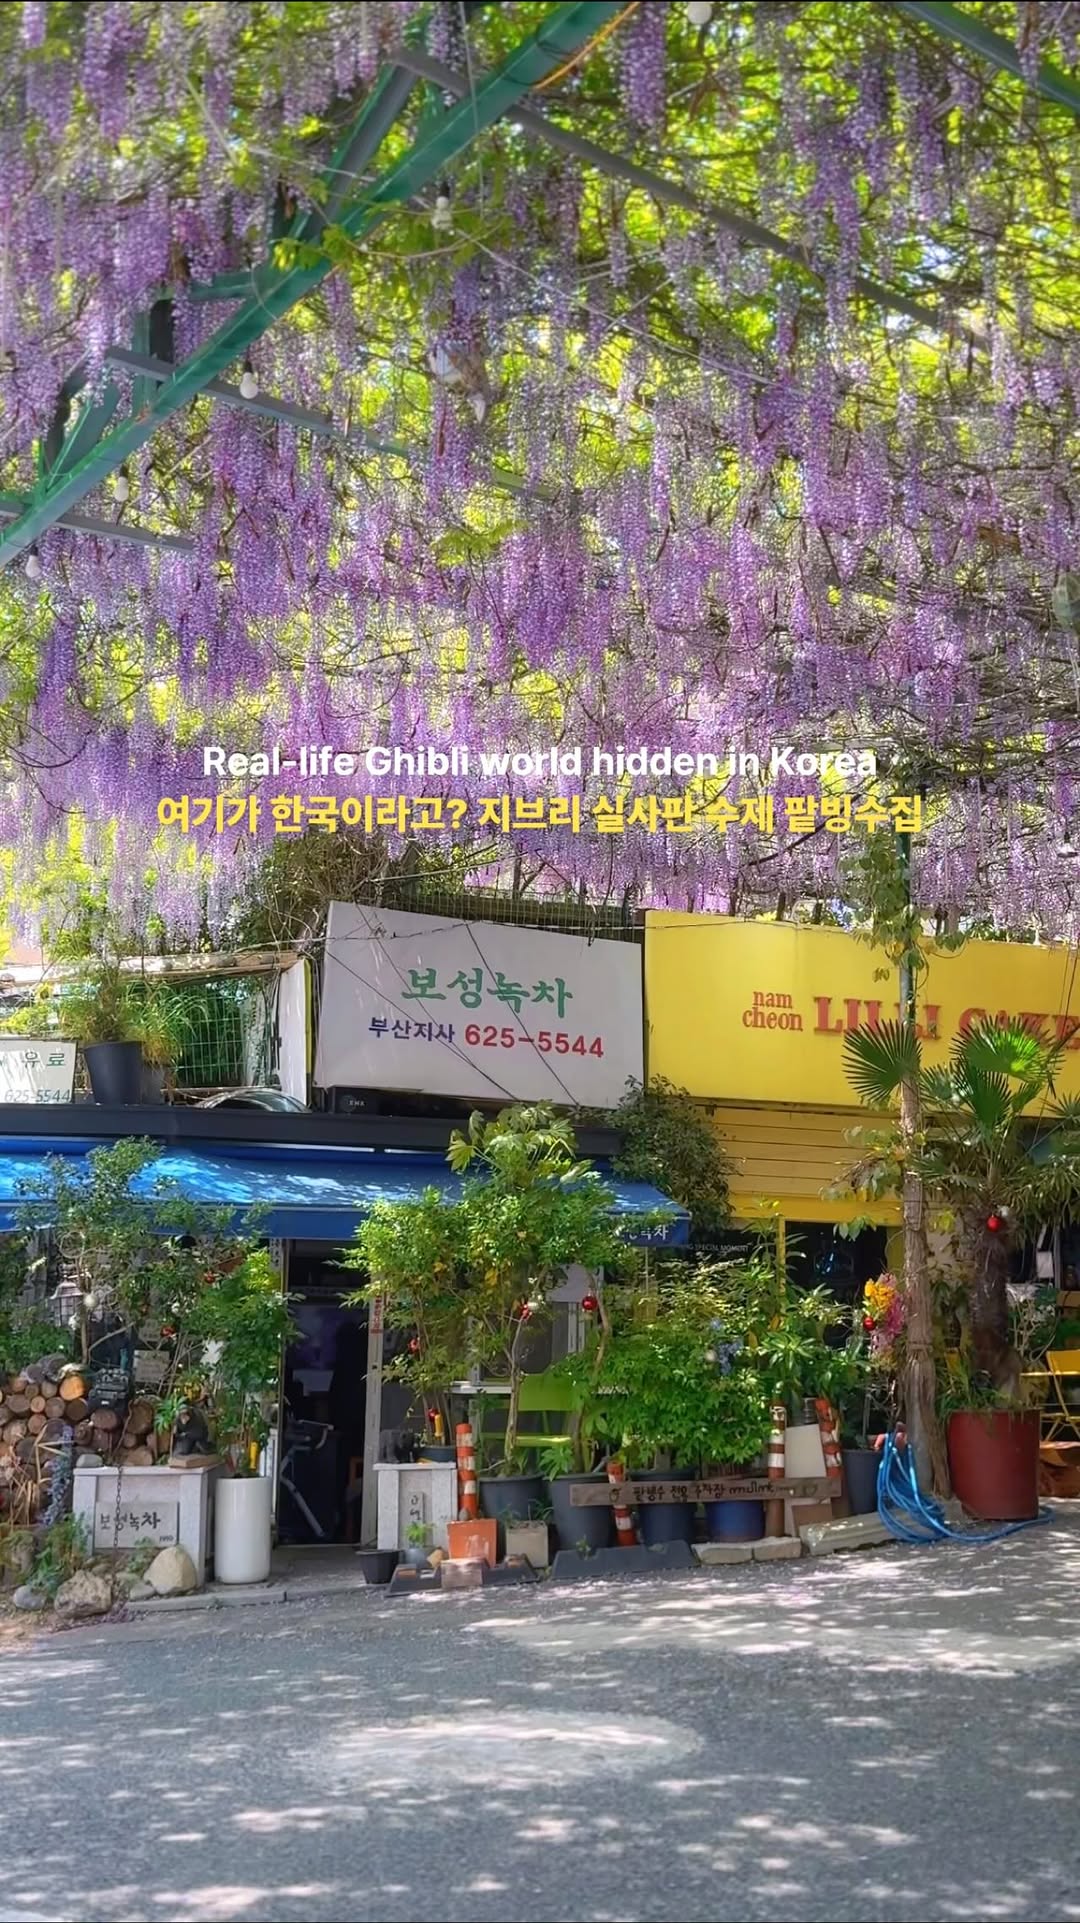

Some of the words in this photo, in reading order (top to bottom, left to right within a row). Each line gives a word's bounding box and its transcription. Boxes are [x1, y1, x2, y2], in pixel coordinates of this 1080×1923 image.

[402, 967, 573, 1018] 보성녹차
[753, 991, 793, 1009] nam
[742, 1006, 803, 1032] cheon
[368, 1017, 455, 1043] 부산지사
[464, 1024, 604, 1058] 625-5544
[101, 1512, 161, 1531] 보성녹차
